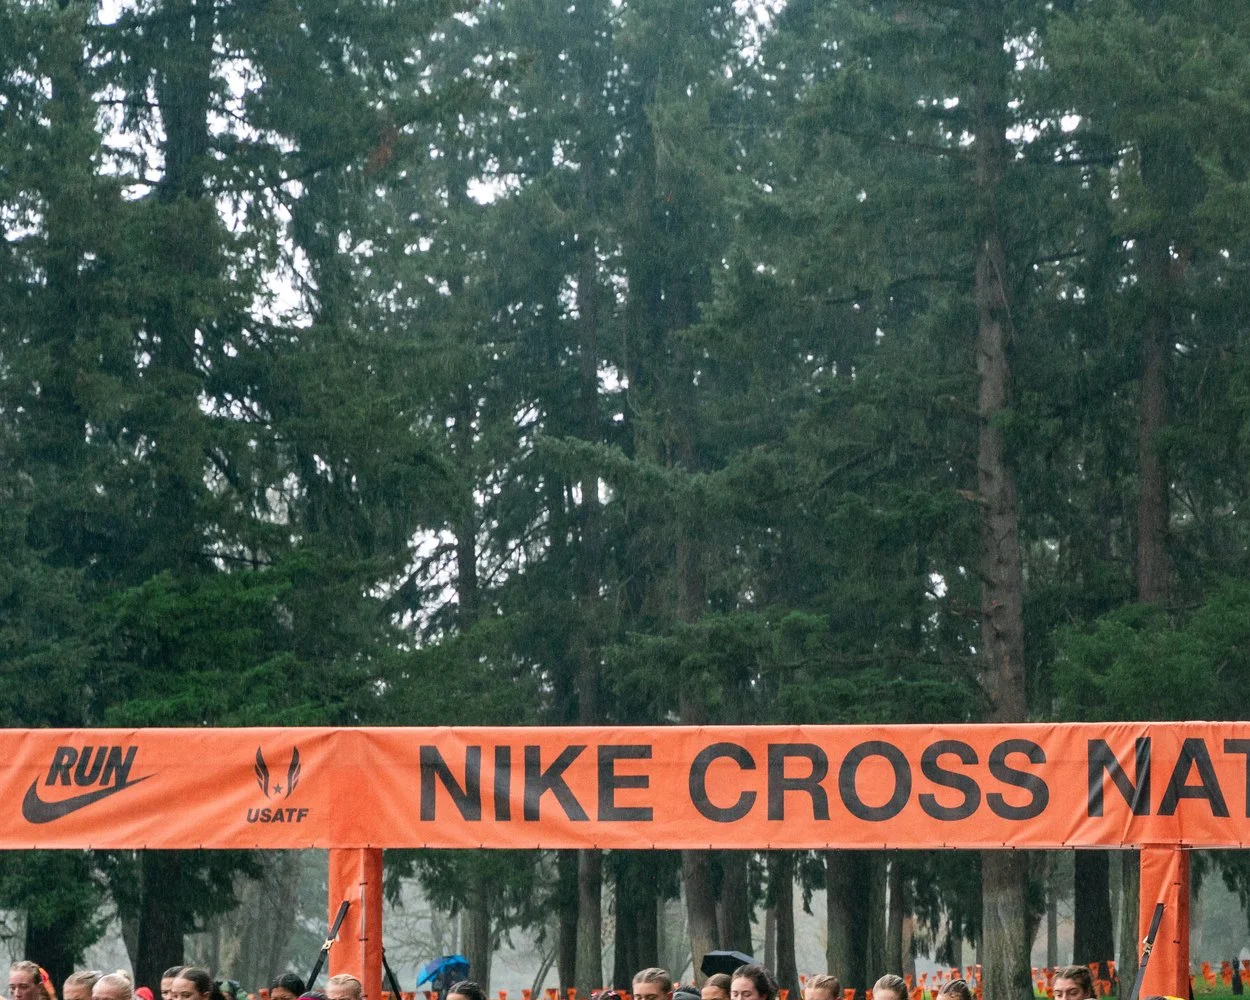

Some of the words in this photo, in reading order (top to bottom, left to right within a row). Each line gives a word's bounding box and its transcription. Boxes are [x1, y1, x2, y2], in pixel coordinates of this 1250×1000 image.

[46, 746, 138, 786] RUN
[420, 744, 653, 822] NIKE
[688, 739, 1050, 823] CROSS
[247, 808, 309, 823] USATF
